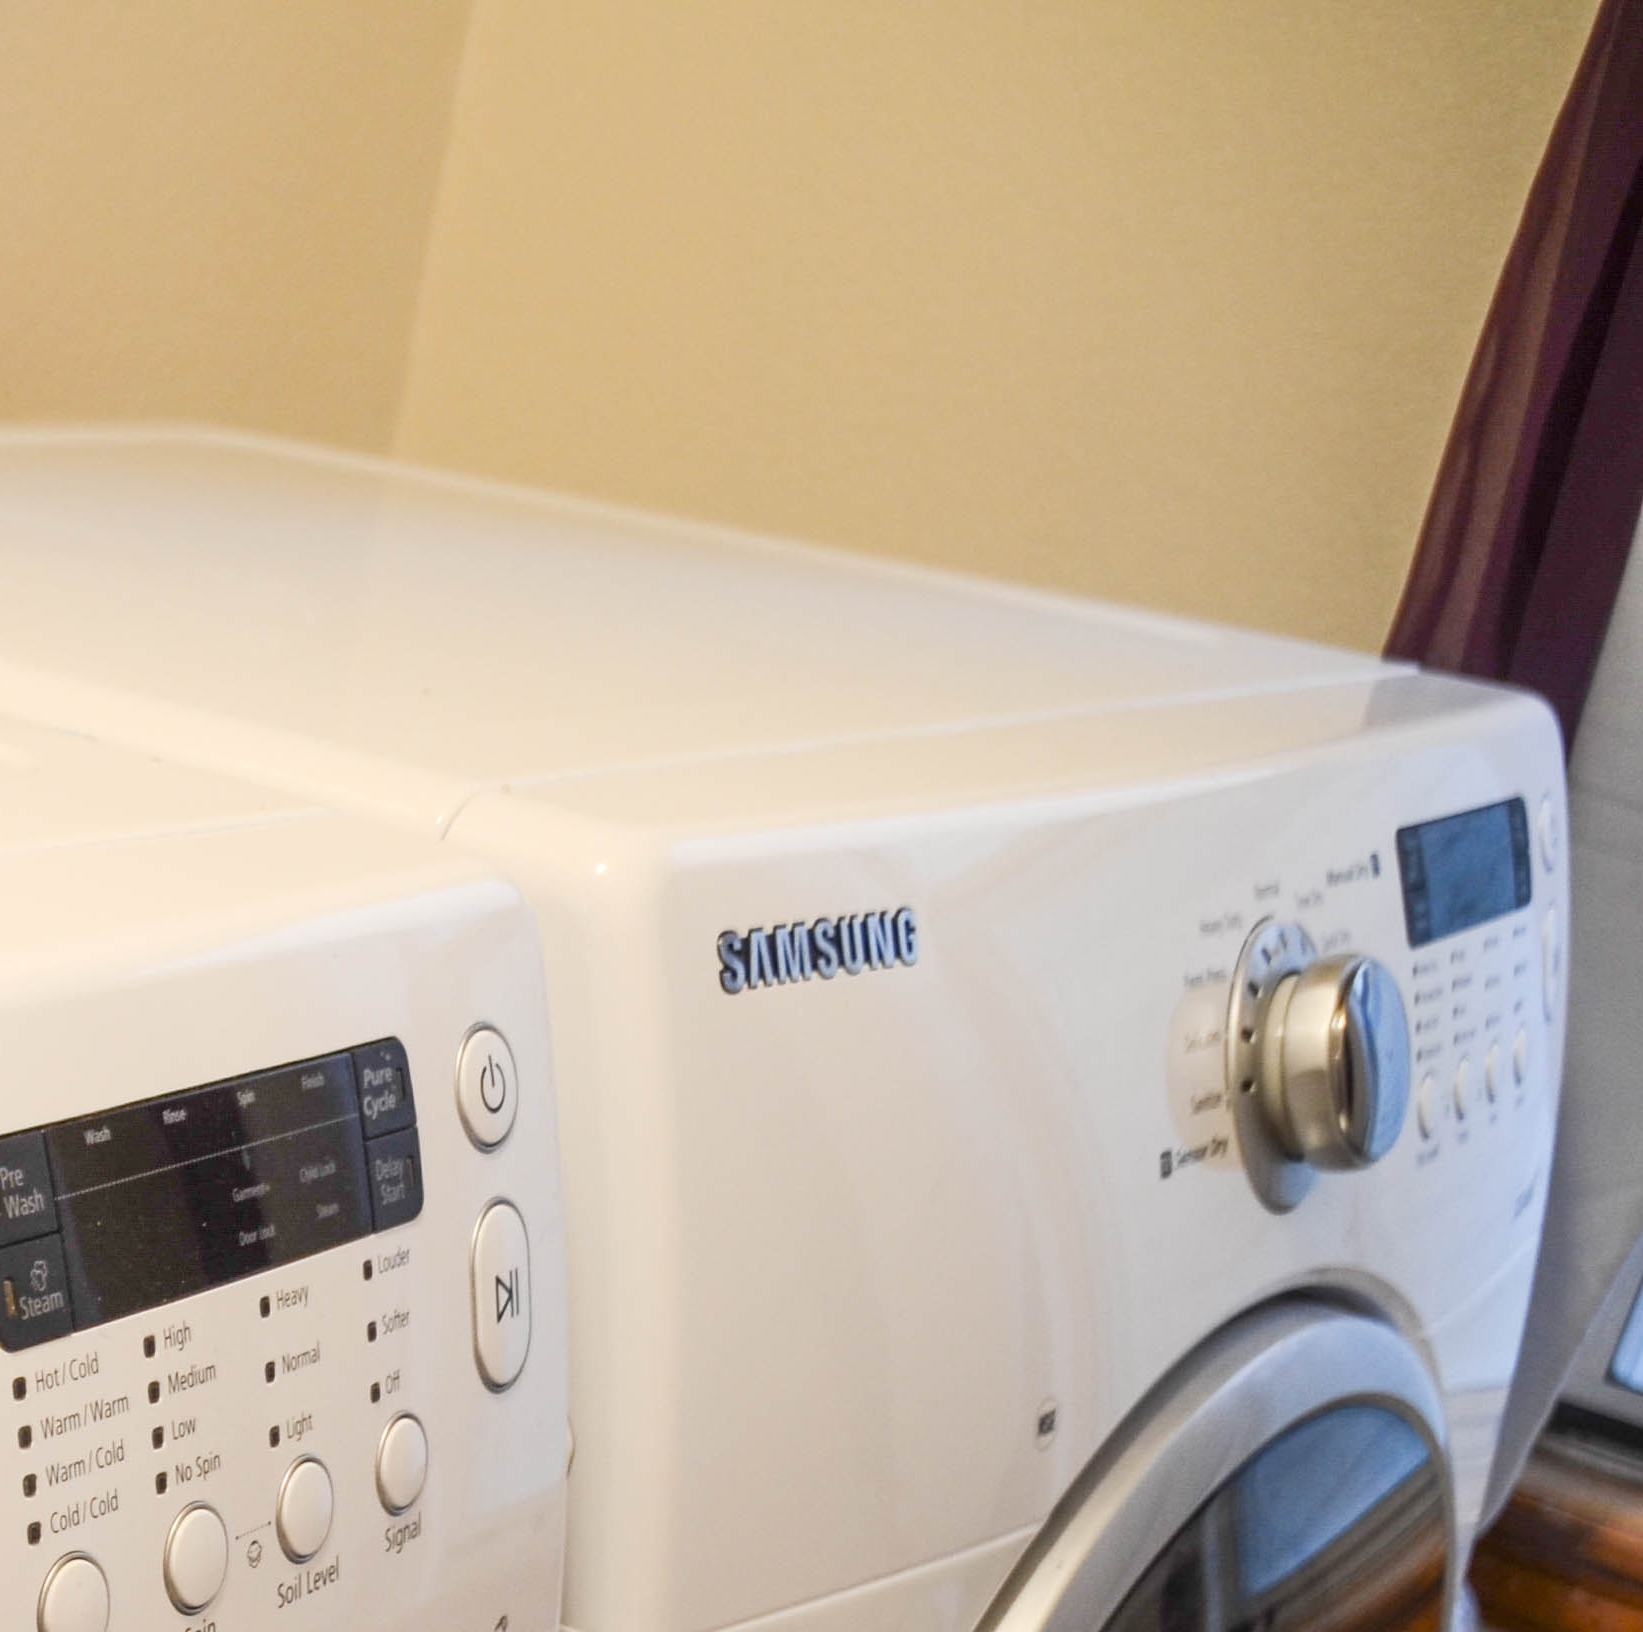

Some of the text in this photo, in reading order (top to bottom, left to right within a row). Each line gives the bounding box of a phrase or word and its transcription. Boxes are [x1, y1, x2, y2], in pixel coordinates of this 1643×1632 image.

[717, 906, 917, 994] SAMSUNG
[363, 1066, 394, 1087] Pure
[363, 1090, 397, 1120] Cycle
[83, 1126, 112, 1145] Wash
[375, 1157, 405, 1182] Delay
[3, 1187, 45, 1220] Wash
[377, 1246, 411, 1275] Louder
[19, 1290, 65, 1321] Steam
[275, 1285, 310, 1312] Heavy
[163, 1320, 192, 1352] High
[381, 1308, 411, 1336] Softer
[281, 1340, 321, 1375] Normal
[167, 1363, 218, 1397] Medium
[385, 1367, 402, 1395] Off
[171, 1417, 198, 1441] Low
[286, 1411, 315, 1443] Light
[175, 1450, 221, 1486] No Spin
[383, 1511, 423, 1554] Signal
[276, 1556, 341, 1610] Soil Level
